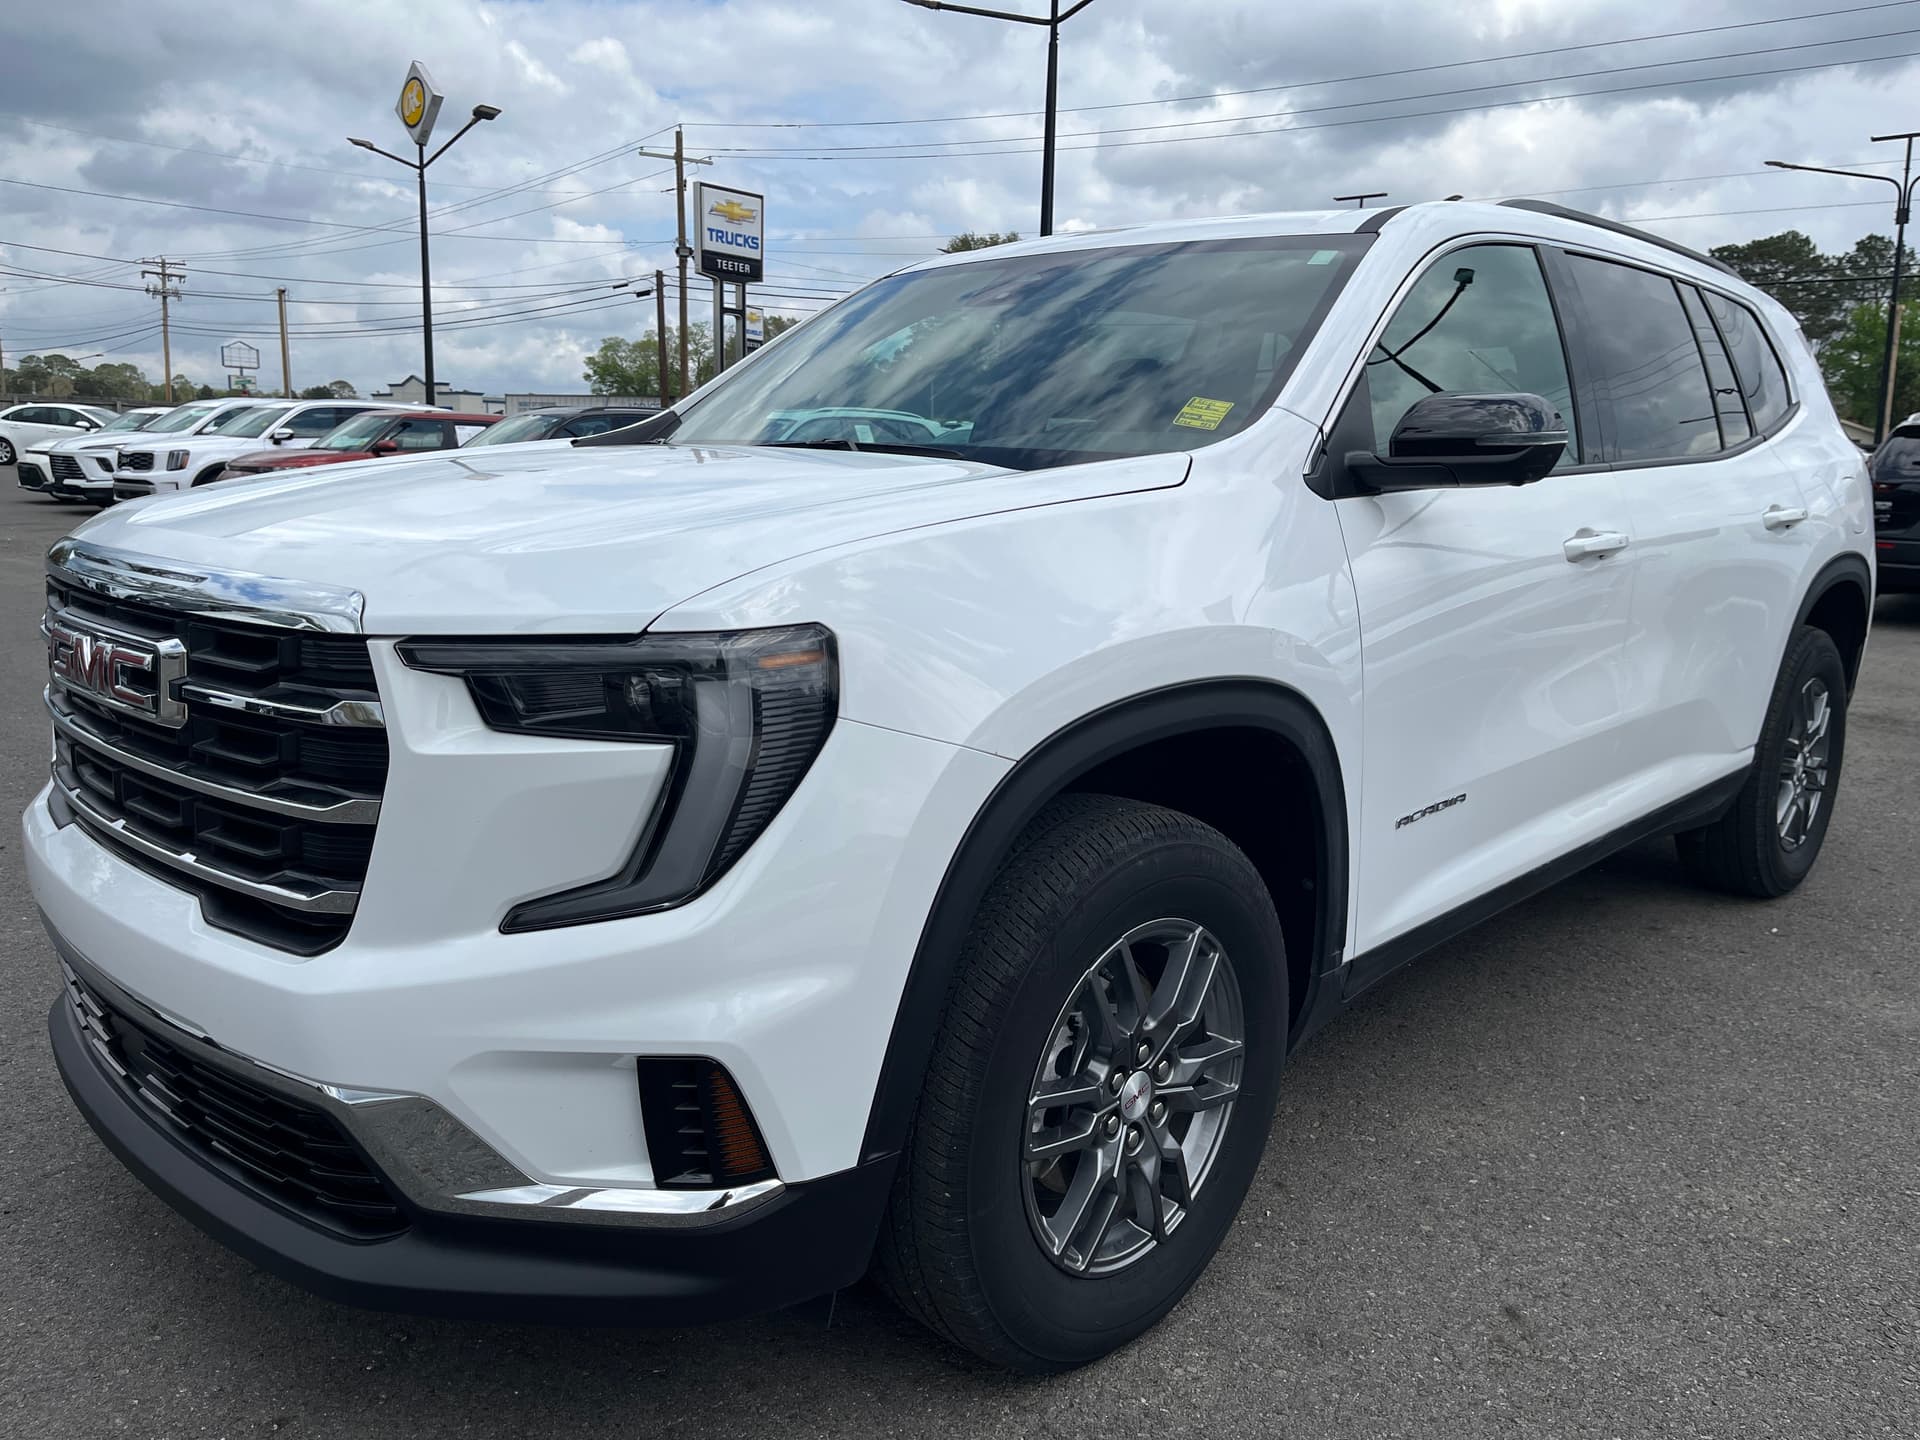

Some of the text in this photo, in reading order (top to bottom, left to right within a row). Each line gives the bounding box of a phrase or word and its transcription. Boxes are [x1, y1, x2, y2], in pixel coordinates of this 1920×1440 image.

[707, 227, 759, 250] TRUCKS
[716, 259, 750, 274] TEETER
[50, 625, 157, 711] GMC
[1395, 793, 1467, 830] ACADIA
[1124, 1082, 1150, 1110] GMC
